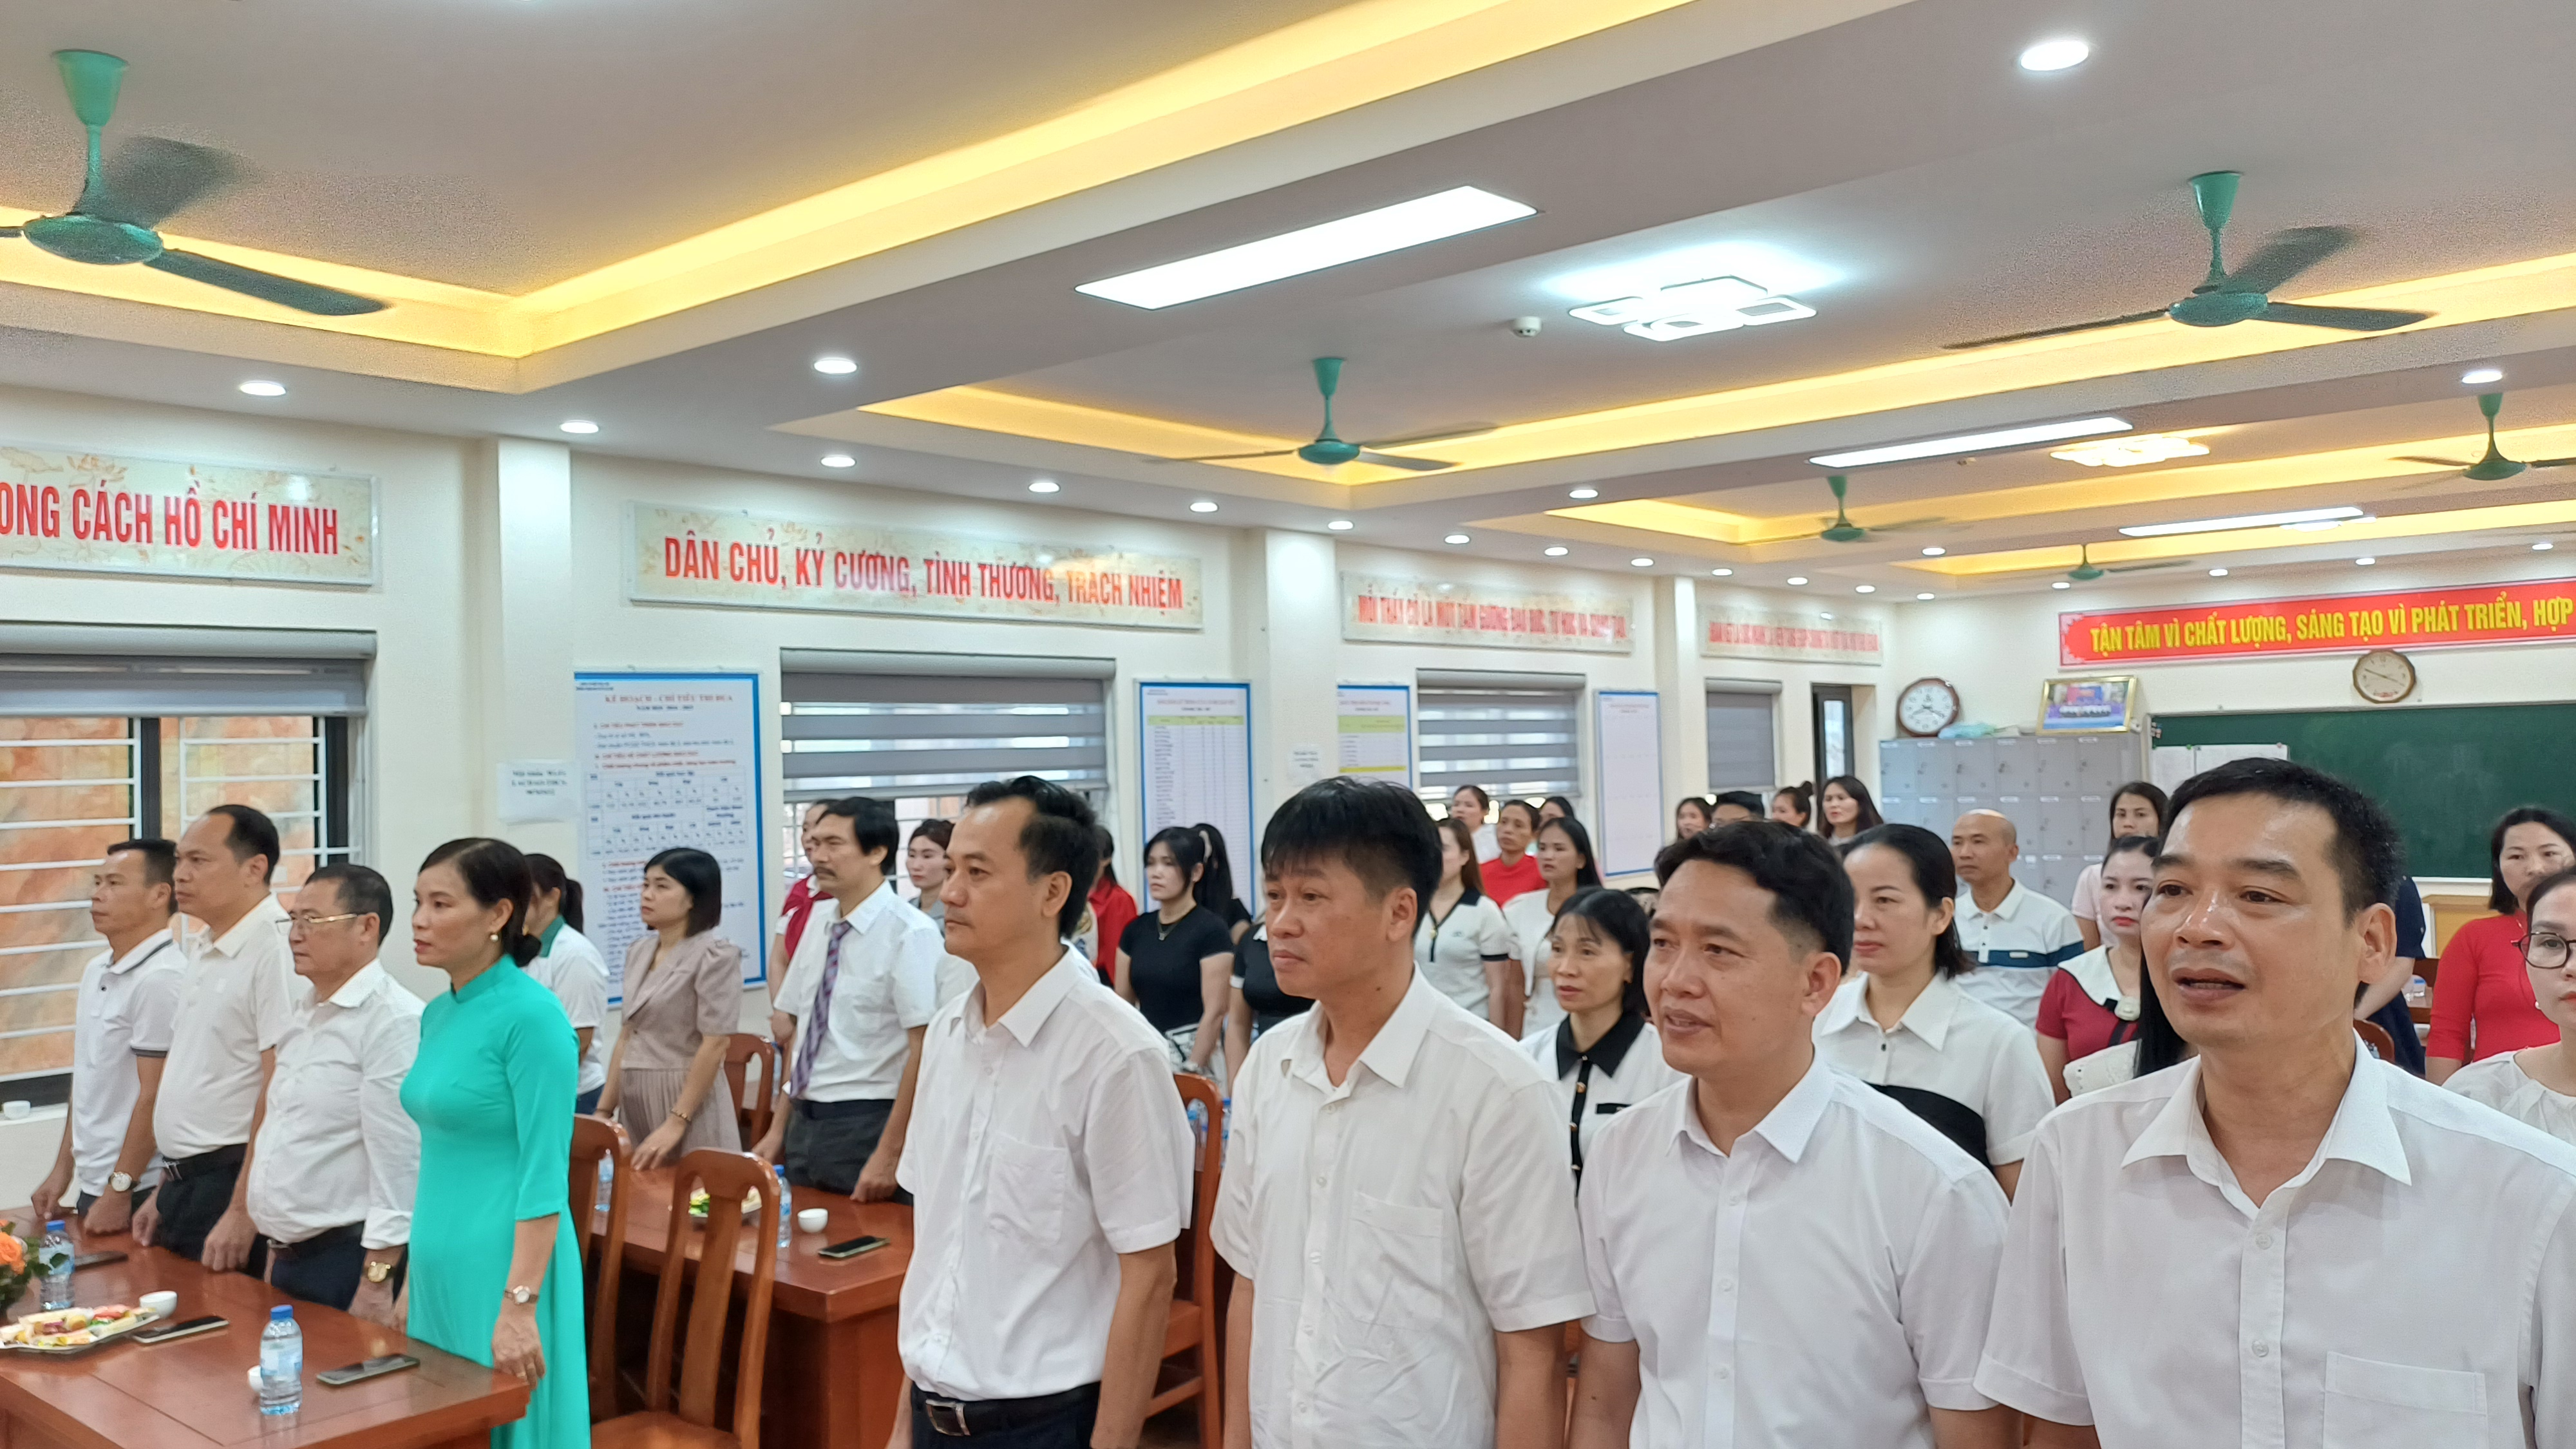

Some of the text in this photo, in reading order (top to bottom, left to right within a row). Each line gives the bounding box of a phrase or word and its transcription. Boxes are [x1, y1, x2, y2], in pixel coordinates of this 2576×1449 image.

[0, 479, 337, 554] ONG CÁCH HỒ CHÍ MINH
[665, 530, 719, 580] DÂN
[730, 528, 786, 589] CHỦ,
[795, 532, 826, 587] KỶ
[834, 549, 917, 598] CƯƠNG,
[923, 551, 972, 596] TÌNH
[978, 562, 1060, 606] THƯƠNG,
[1130, 570, 1184, 615] NHIỆM
[2090, 591, 2574, 658] TẬN TÂM VÌ CHẤT LƯỢNG, SÁNG TẠO VÌ PHÁT TRIỂN, HỢP
